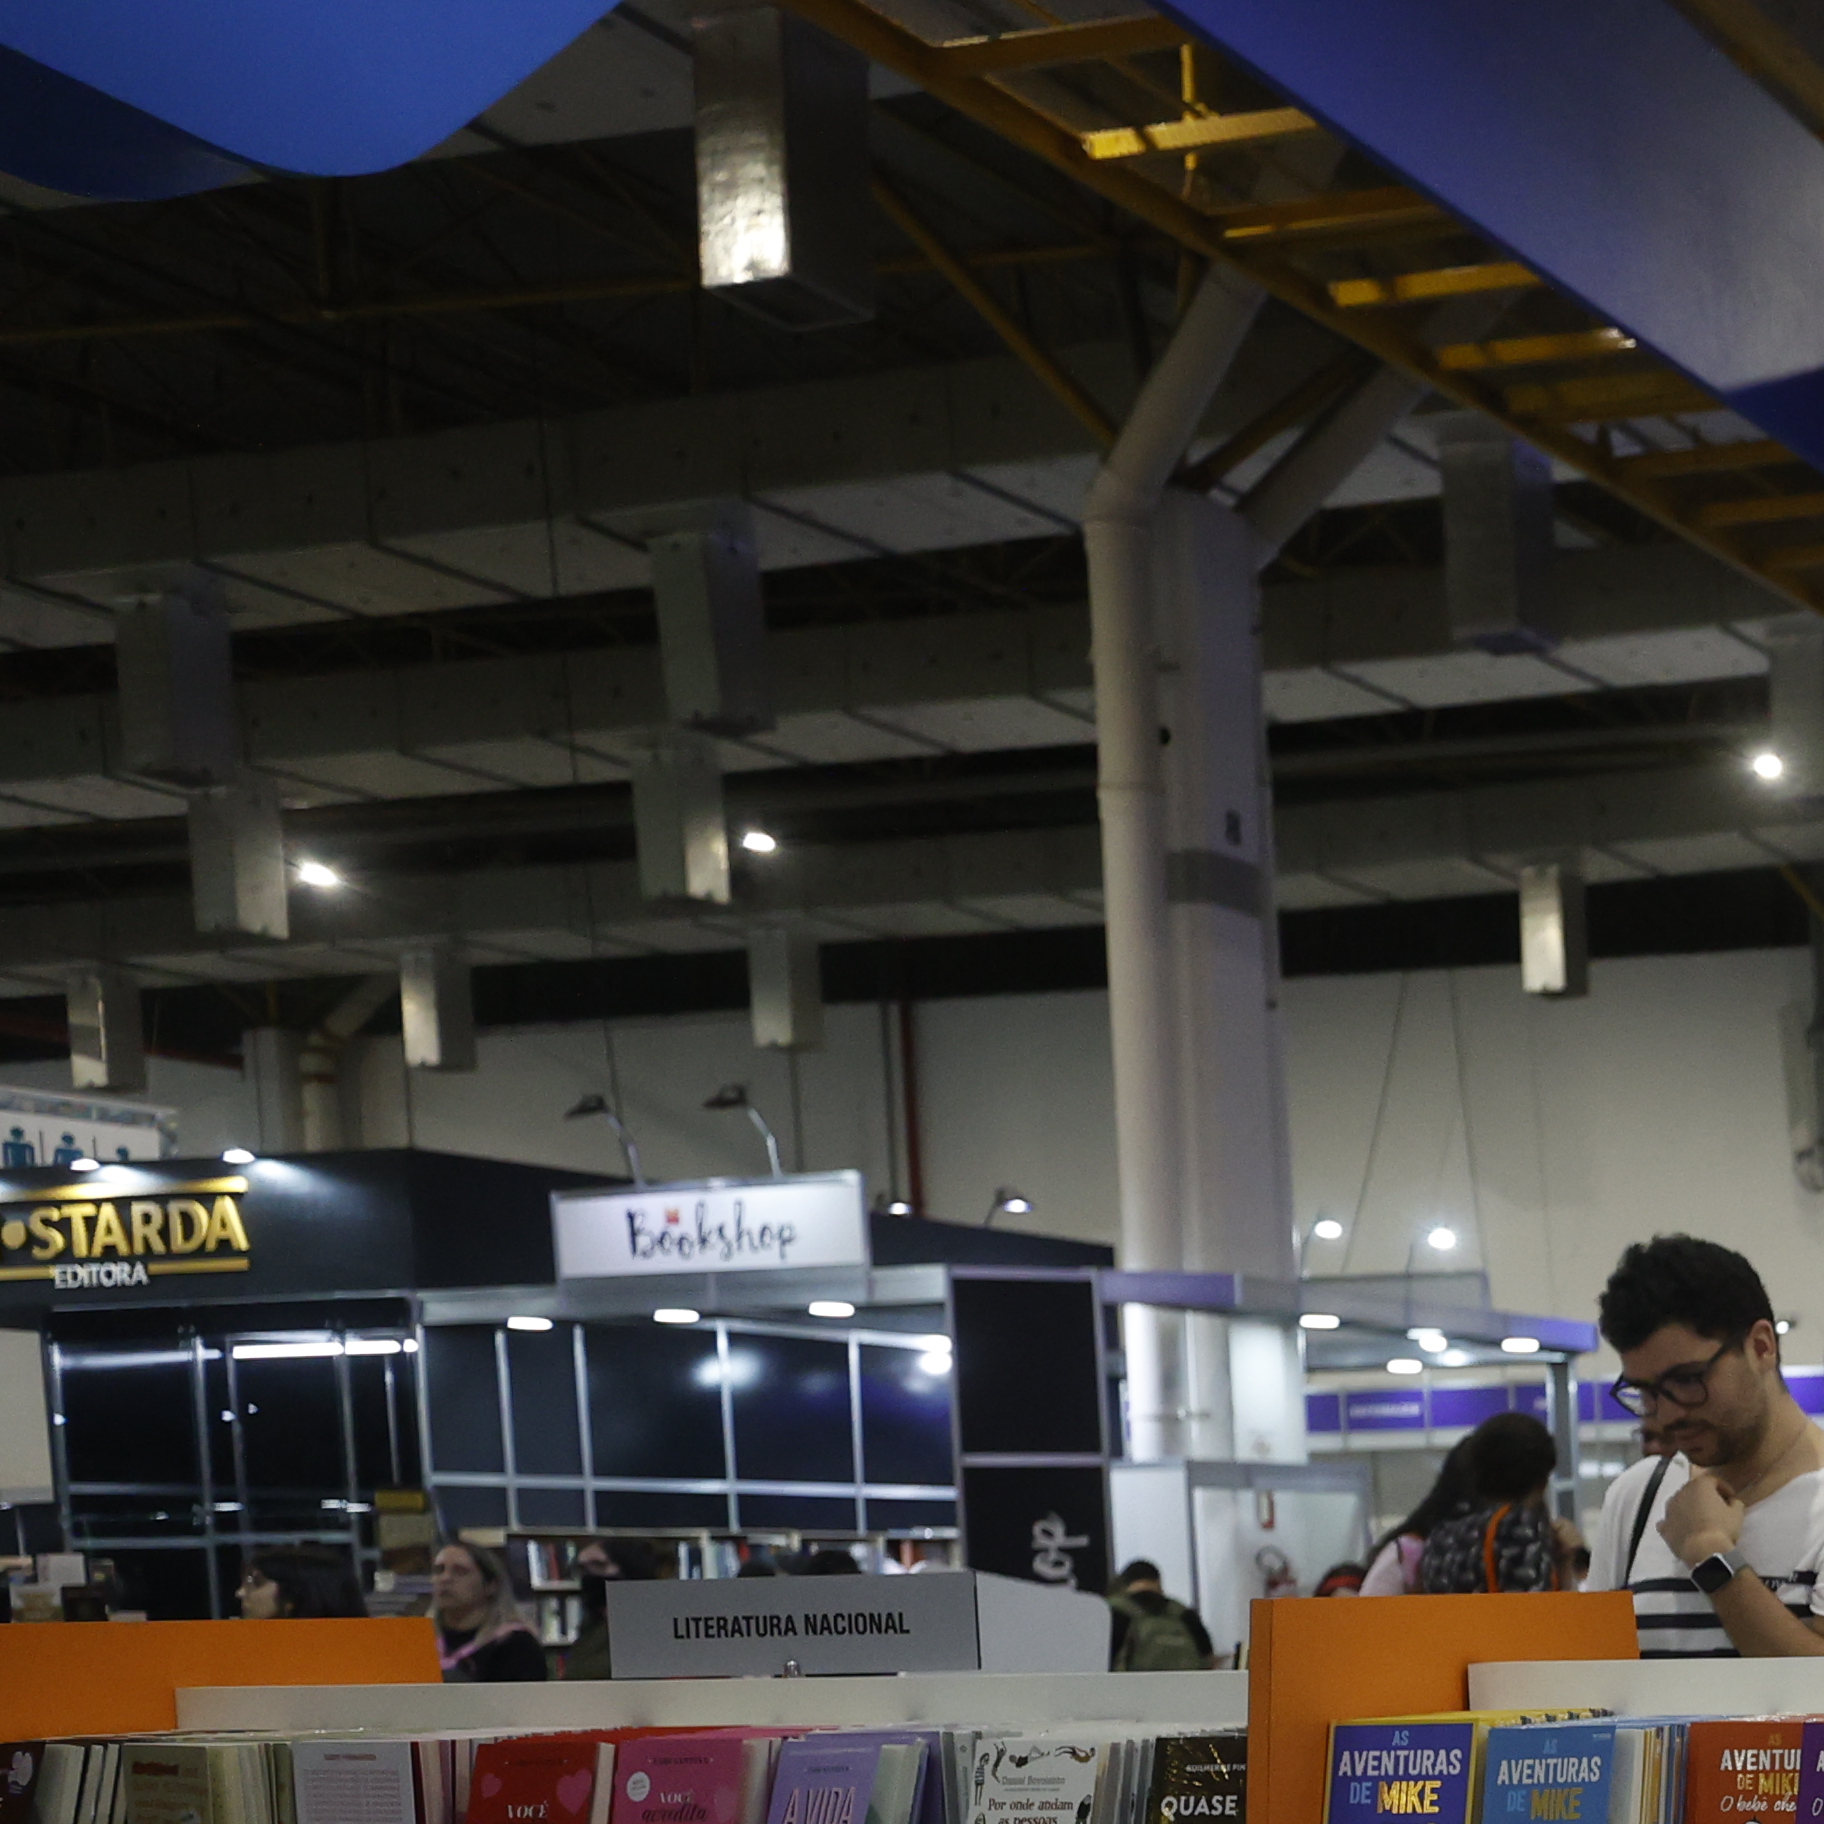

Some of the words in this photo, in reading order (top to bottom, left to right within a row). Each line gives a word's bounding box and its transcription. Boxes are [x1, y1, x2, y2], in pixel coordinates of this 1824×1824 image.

[625, 1198, 799, 1264] Bookshop
[53, 1260, 150, 1290] EDITORA
[673, 1613, 798, 1640] LITERATURA
[804, 1611, 911, 1637] NACIONAL
[1338, 1749, 1463, 1777] AVENTURAS
[1497, 1756, 1602, 1785] AVENTURAS
[988, 1798, 1008, 1812] Por
[1009, 1799, 1035, 1812] onde
[1037, 1798, 1074, 1812] andam
[1160, 1795, 1239, 1821] QUASE
[1349, 1781, 1373, 1805] DE
[1376, 1780, 1443, 1815] MIKE
[1506, 1789, 1526, 1813] DE
[1530, 1787, 1584, 1821] MIKE
